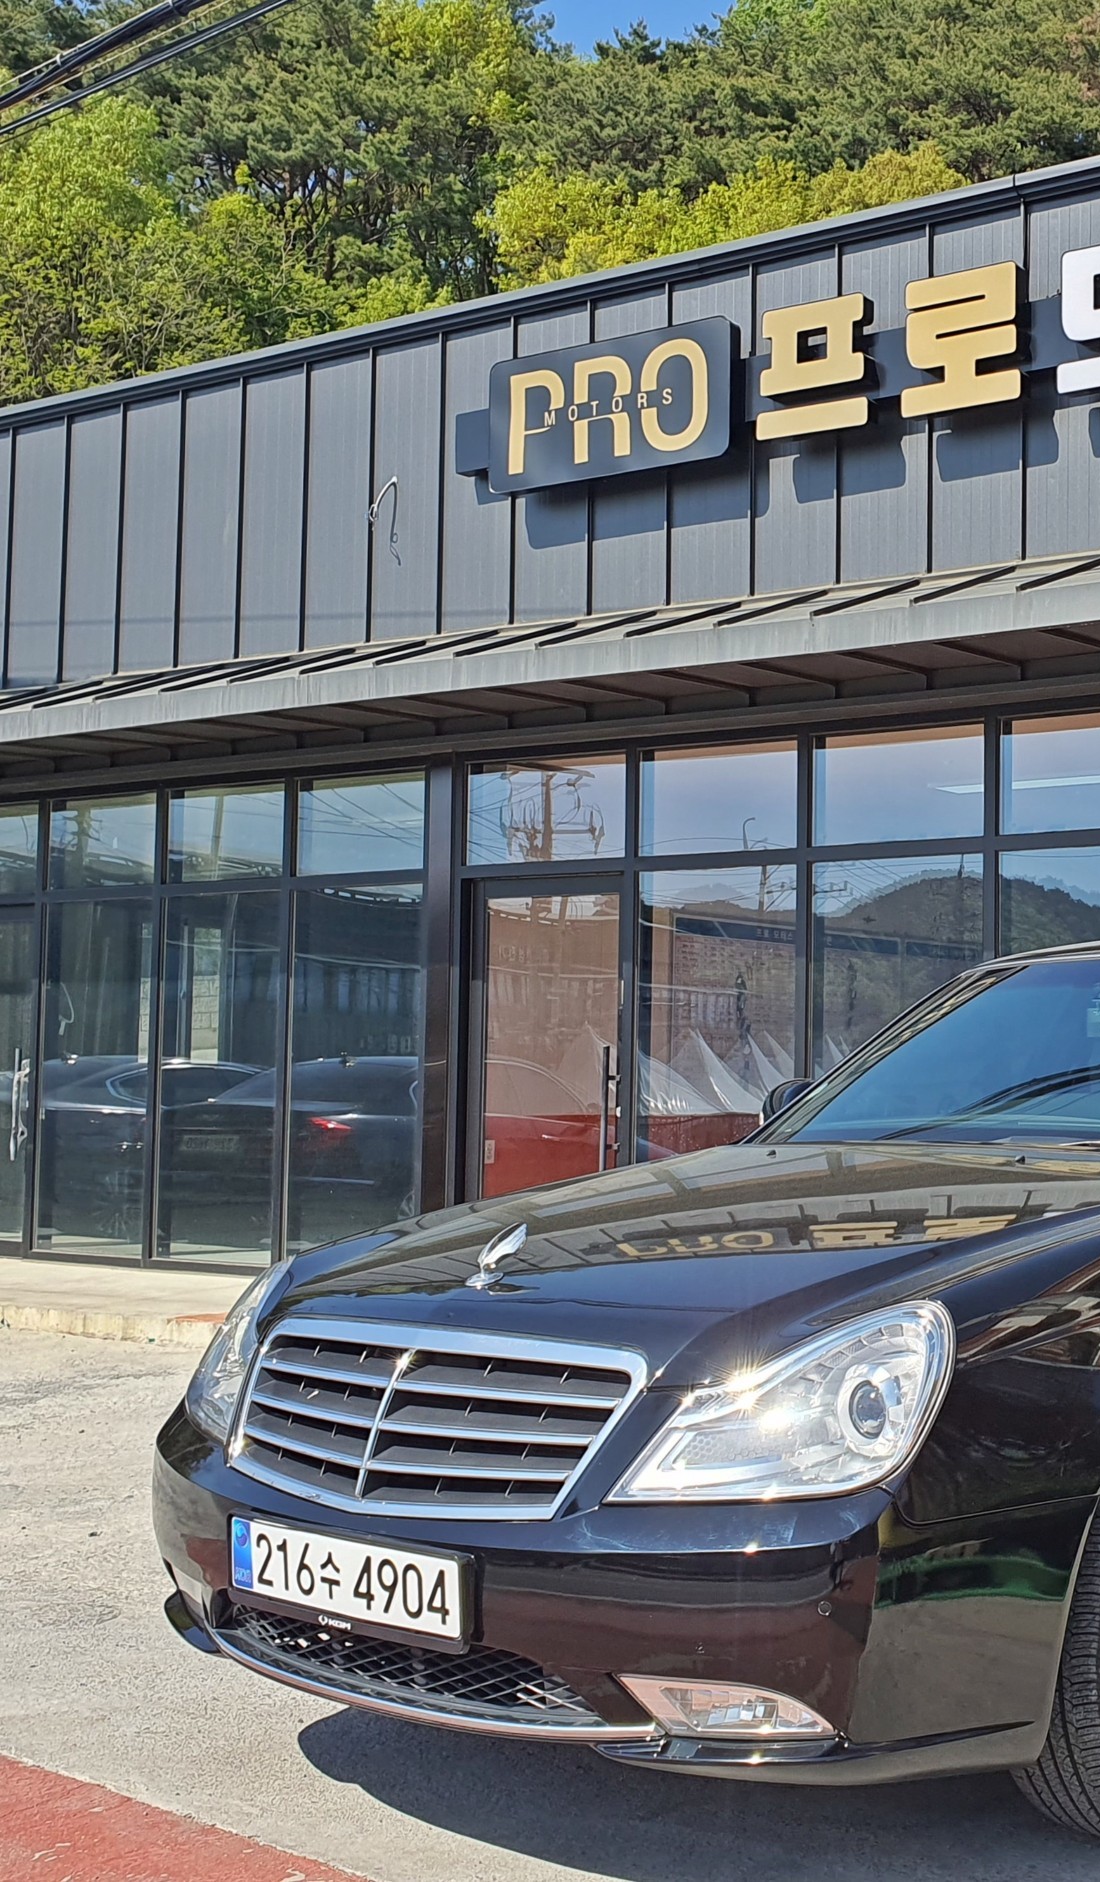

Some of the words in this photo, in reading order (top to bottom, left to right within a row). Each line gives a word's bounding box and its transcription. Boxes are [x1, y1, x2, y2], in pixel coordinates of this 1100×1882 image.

[507, 338, 709, 476] PRO
[544, 387, 674, 427] MOTORS
[256, 1532, 341, 1600] 216수
[353, 1555, 450, 1626] 4904
